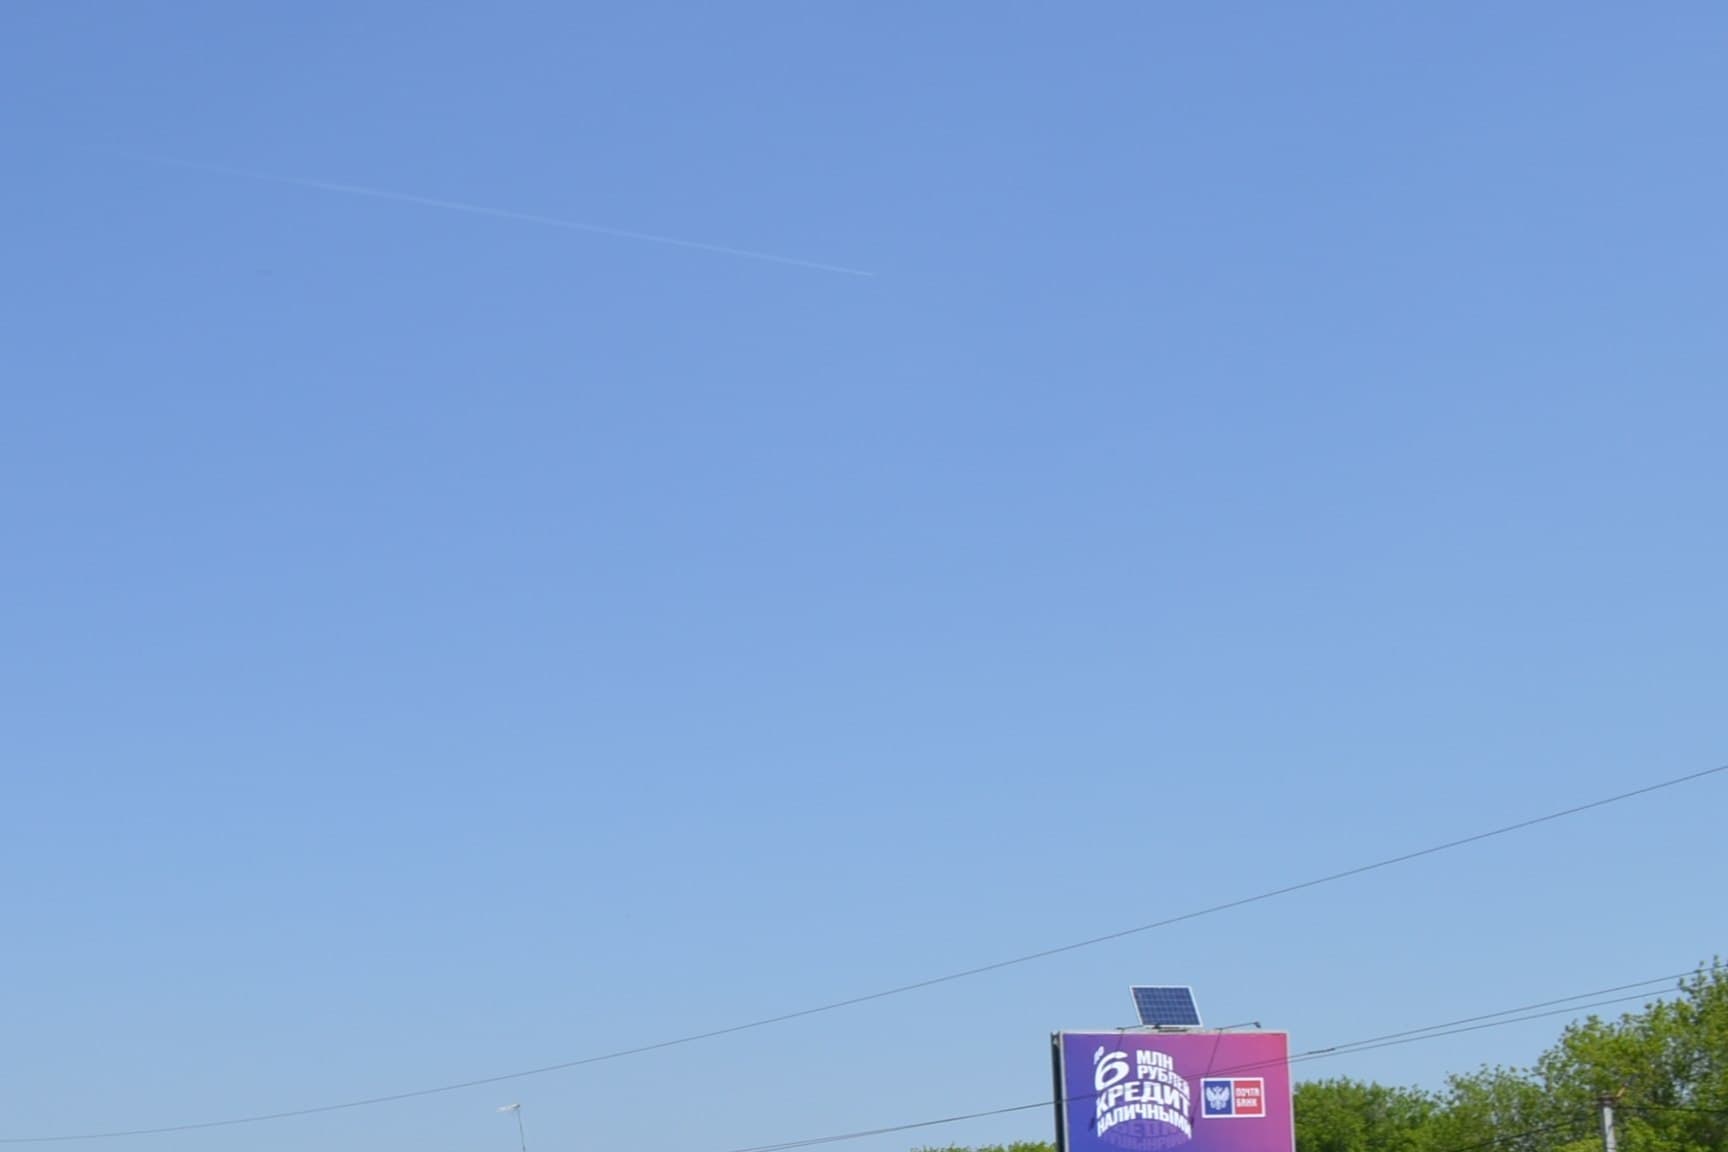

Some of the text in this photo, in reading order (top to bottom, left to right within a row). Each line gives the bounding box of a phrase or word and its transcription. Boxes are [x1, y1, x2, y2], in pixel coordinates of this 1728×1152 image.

[1095, 1051, 1129, 1091] 6
[1136, 1050, 1173, 1071] МЛН
[1096, 1081, 1191, 1118] КРЕДИТ
[1097, 1103, 1192, 1139] НАЛИЧНЫМИ
